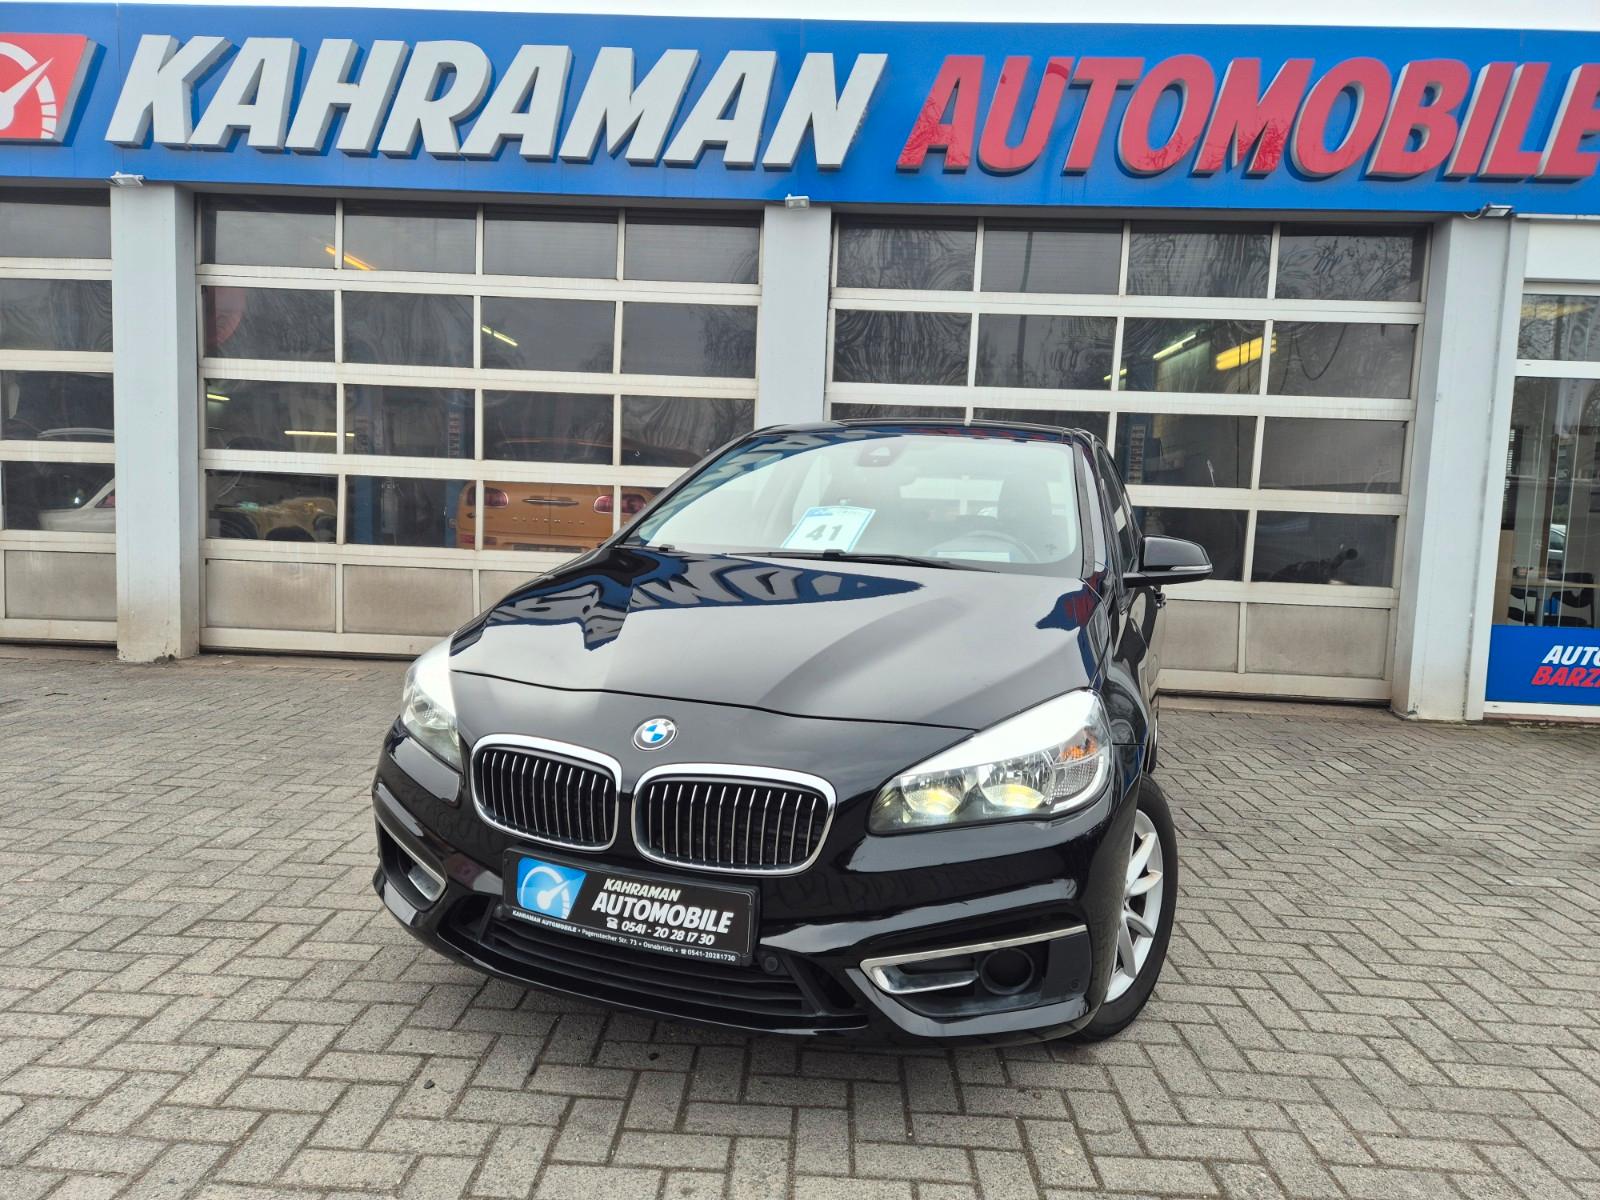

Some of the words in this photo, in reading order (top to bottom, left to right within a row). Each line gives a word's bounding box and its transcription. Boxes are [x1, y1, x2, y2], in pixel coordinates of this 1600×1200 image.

[105, 34, 888, 170] KAHRAMAN
[897, 54, 1600, 179] AUTOMOBILE
[805, 524, 842, 541] 41
[603, 878, 681, 902] KAHRAMAN
[591, 891, 734, 933] AUTOMOBILE
[621, 920, 646, 935] 0541
[653, 926, 669, 939] 20
[670, 929, 685, 941] 28
[686, 932, 699, 943] 17
[698, 933, 715, 946] 30
[643, 941, 674, 953] Osnabrück
